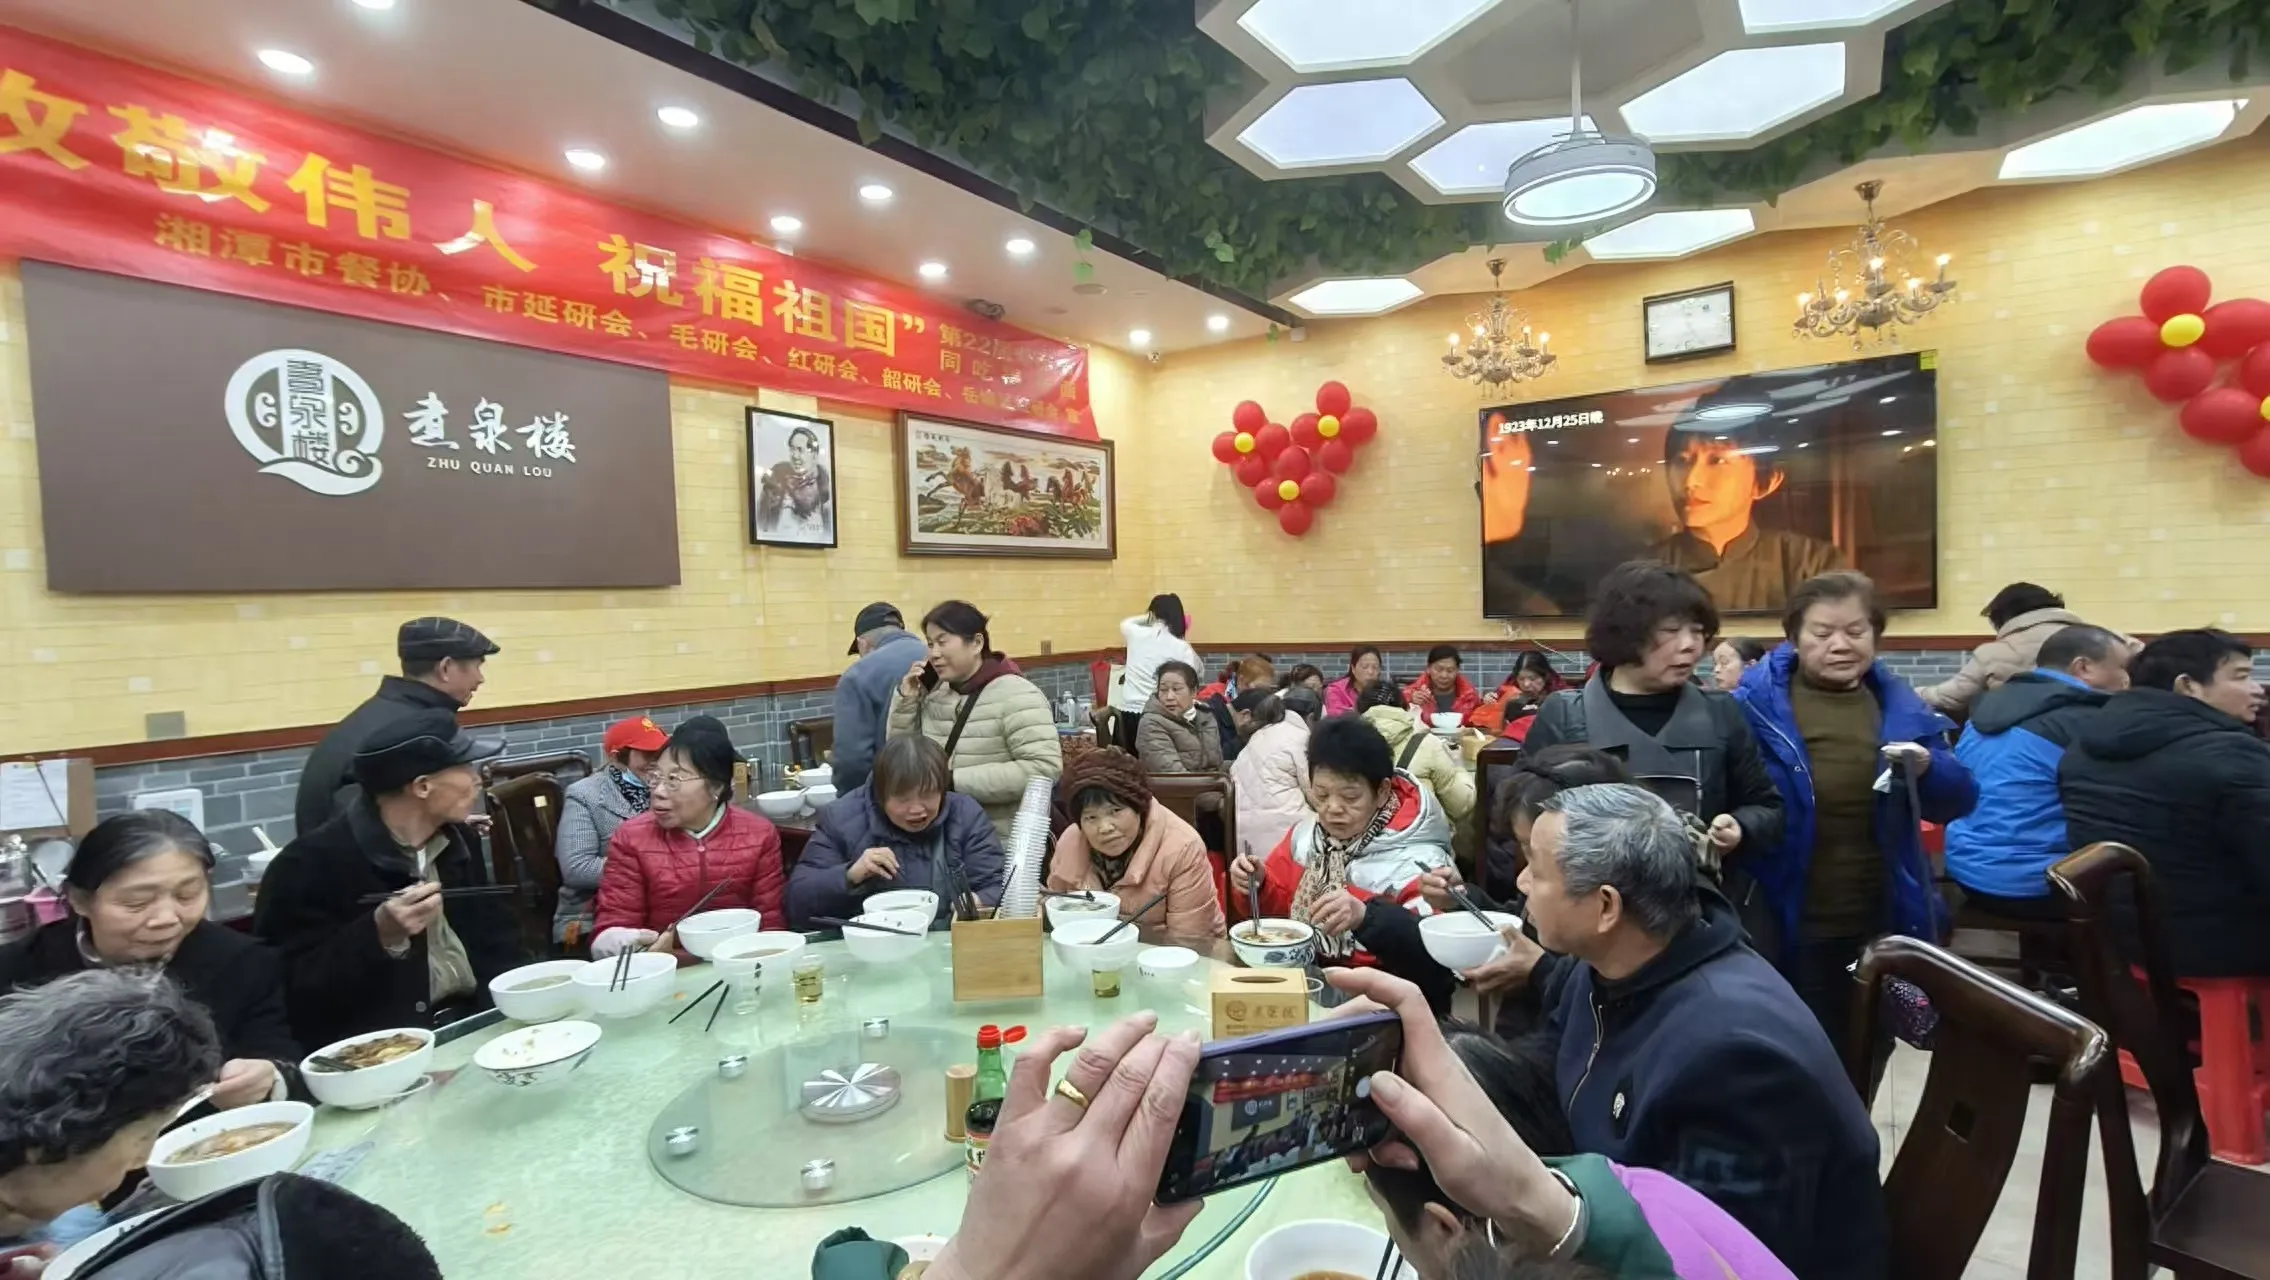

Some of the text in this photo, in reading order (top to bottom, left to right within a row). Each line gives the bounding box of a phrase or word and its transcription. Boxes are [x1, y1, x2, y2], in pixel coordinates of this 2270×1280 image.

[403, 391, 576, 463] 煮泉楼
[427, 456, 553, 478] ZHU QUAN LOU
